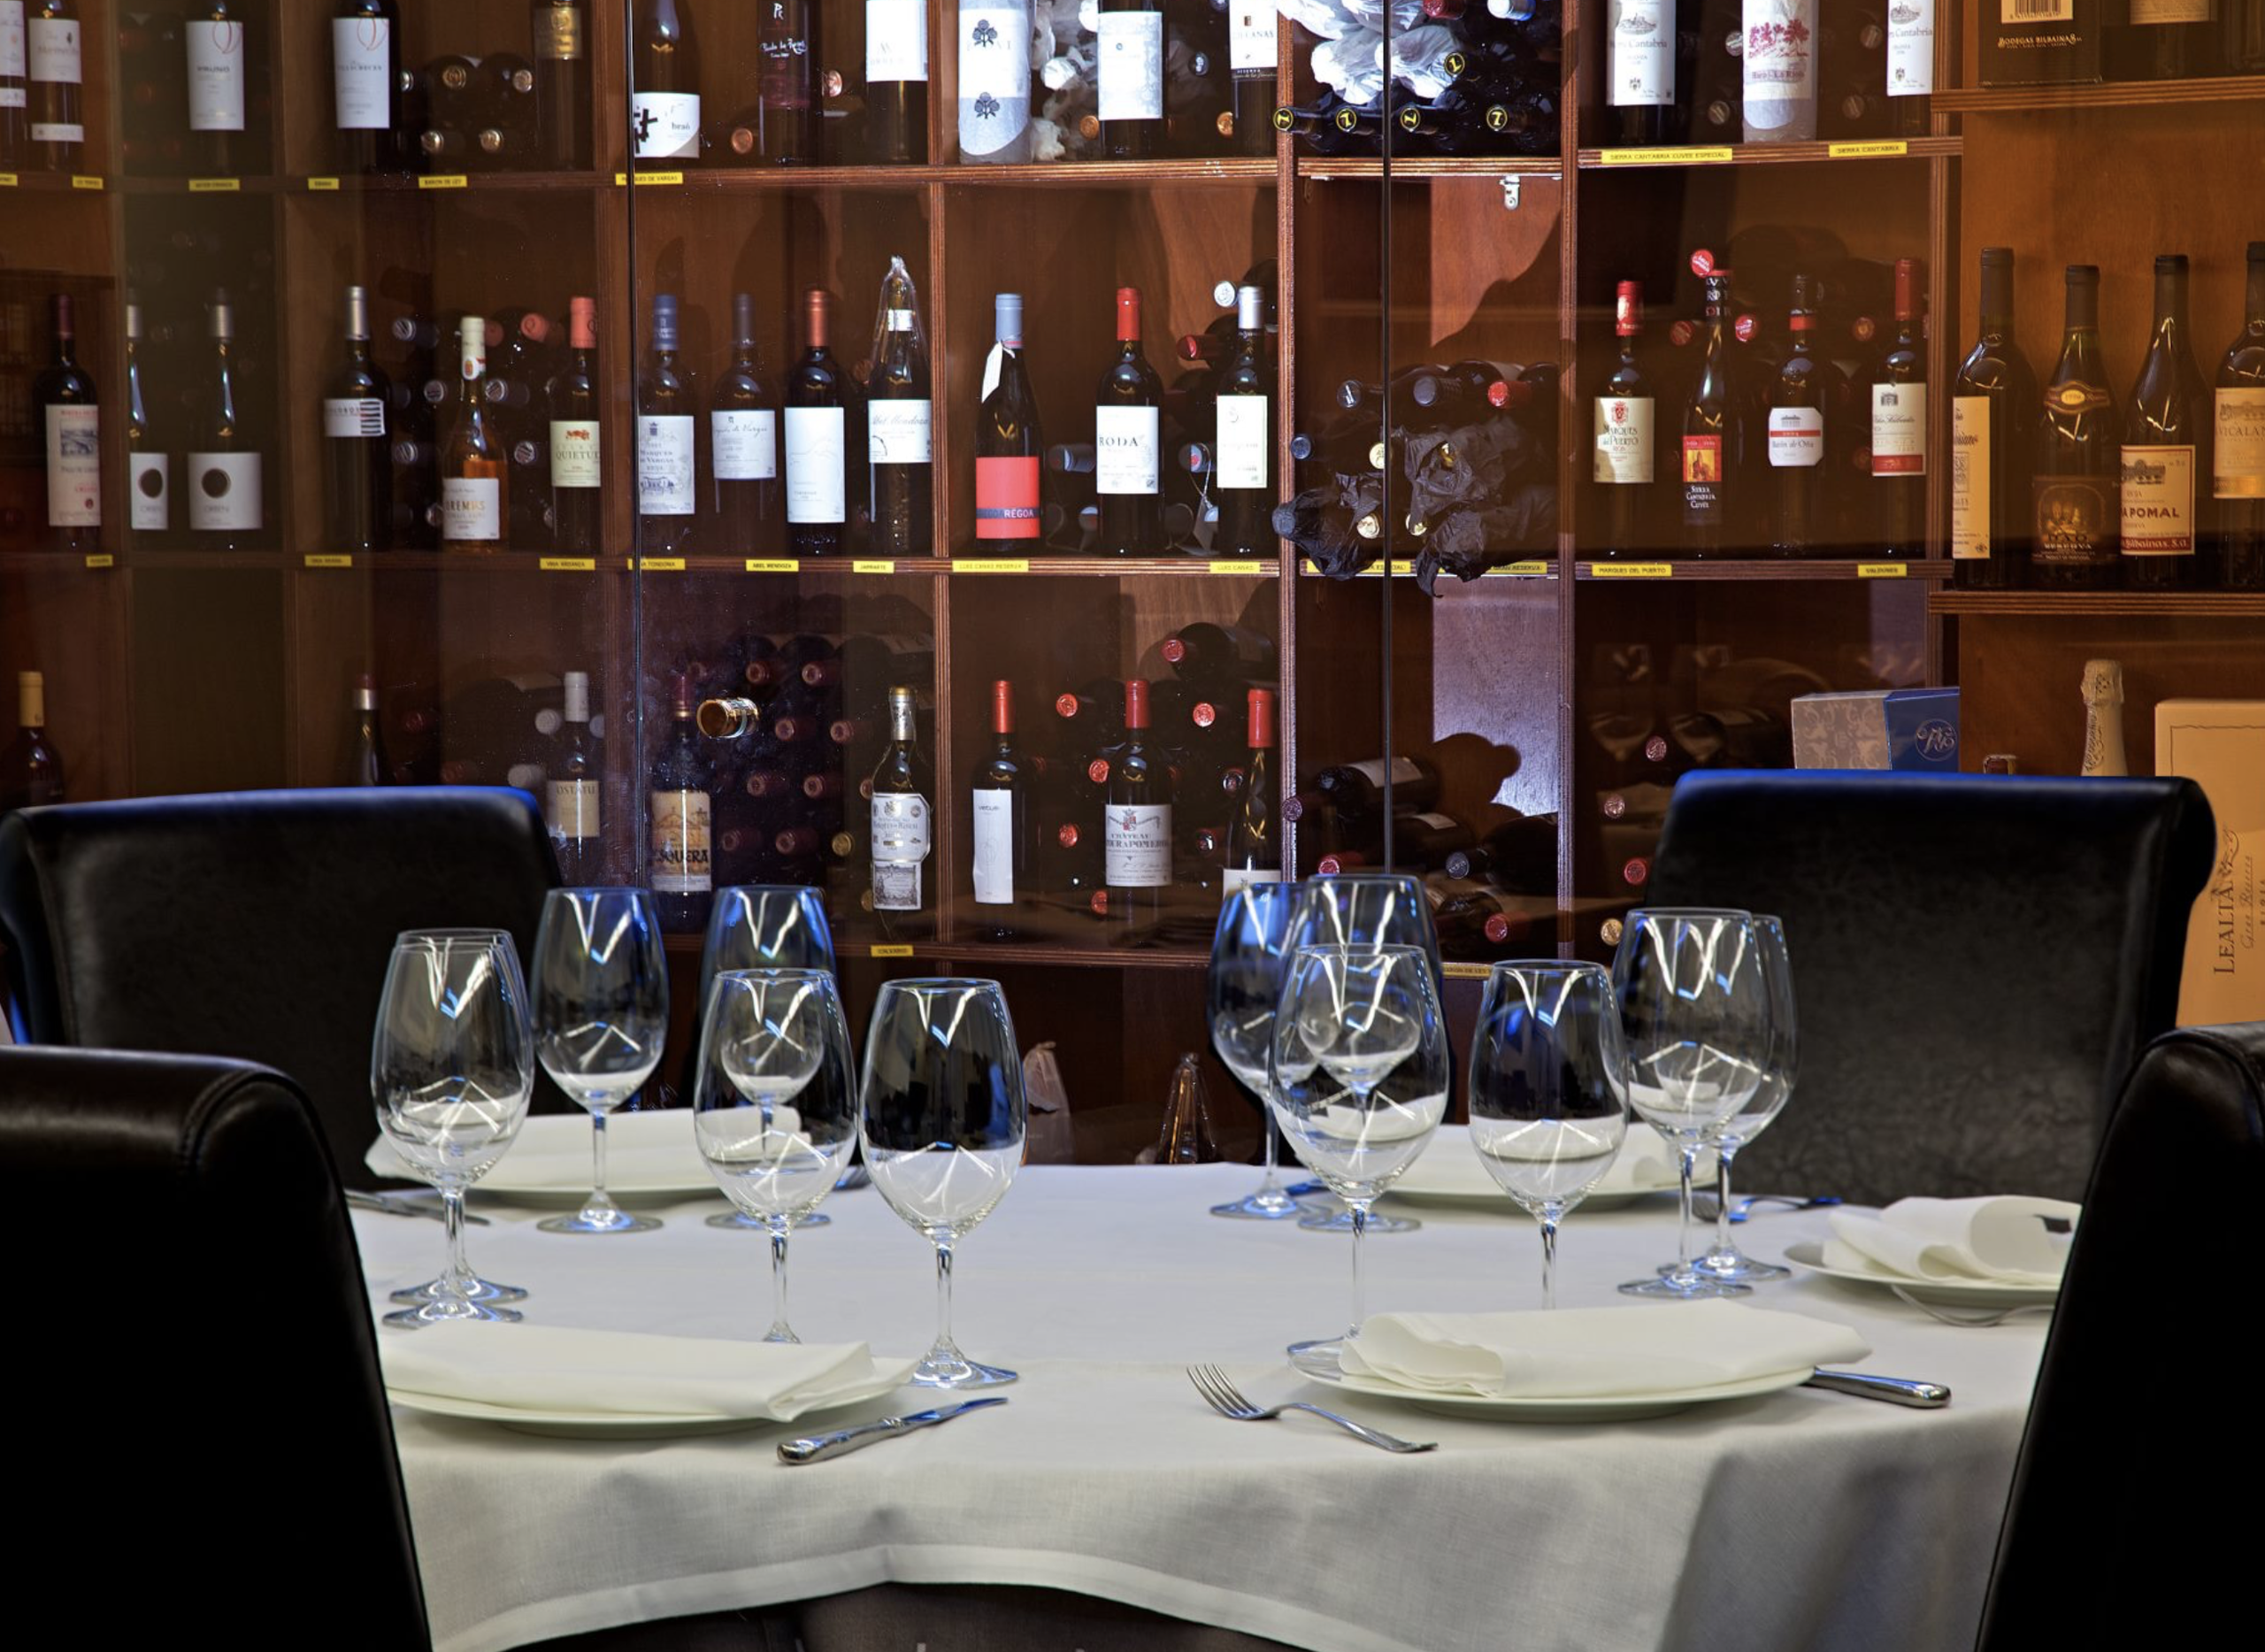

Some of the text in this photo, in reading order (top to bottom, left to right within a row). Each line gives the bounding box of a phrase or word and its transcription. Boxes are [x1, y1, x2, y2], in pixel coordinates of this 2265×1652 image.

[1895, 27, 1932, 37] Cantabria
[1099, 436, 1139, 447] RODA
[556, 786, 595, 795] OSTTU
